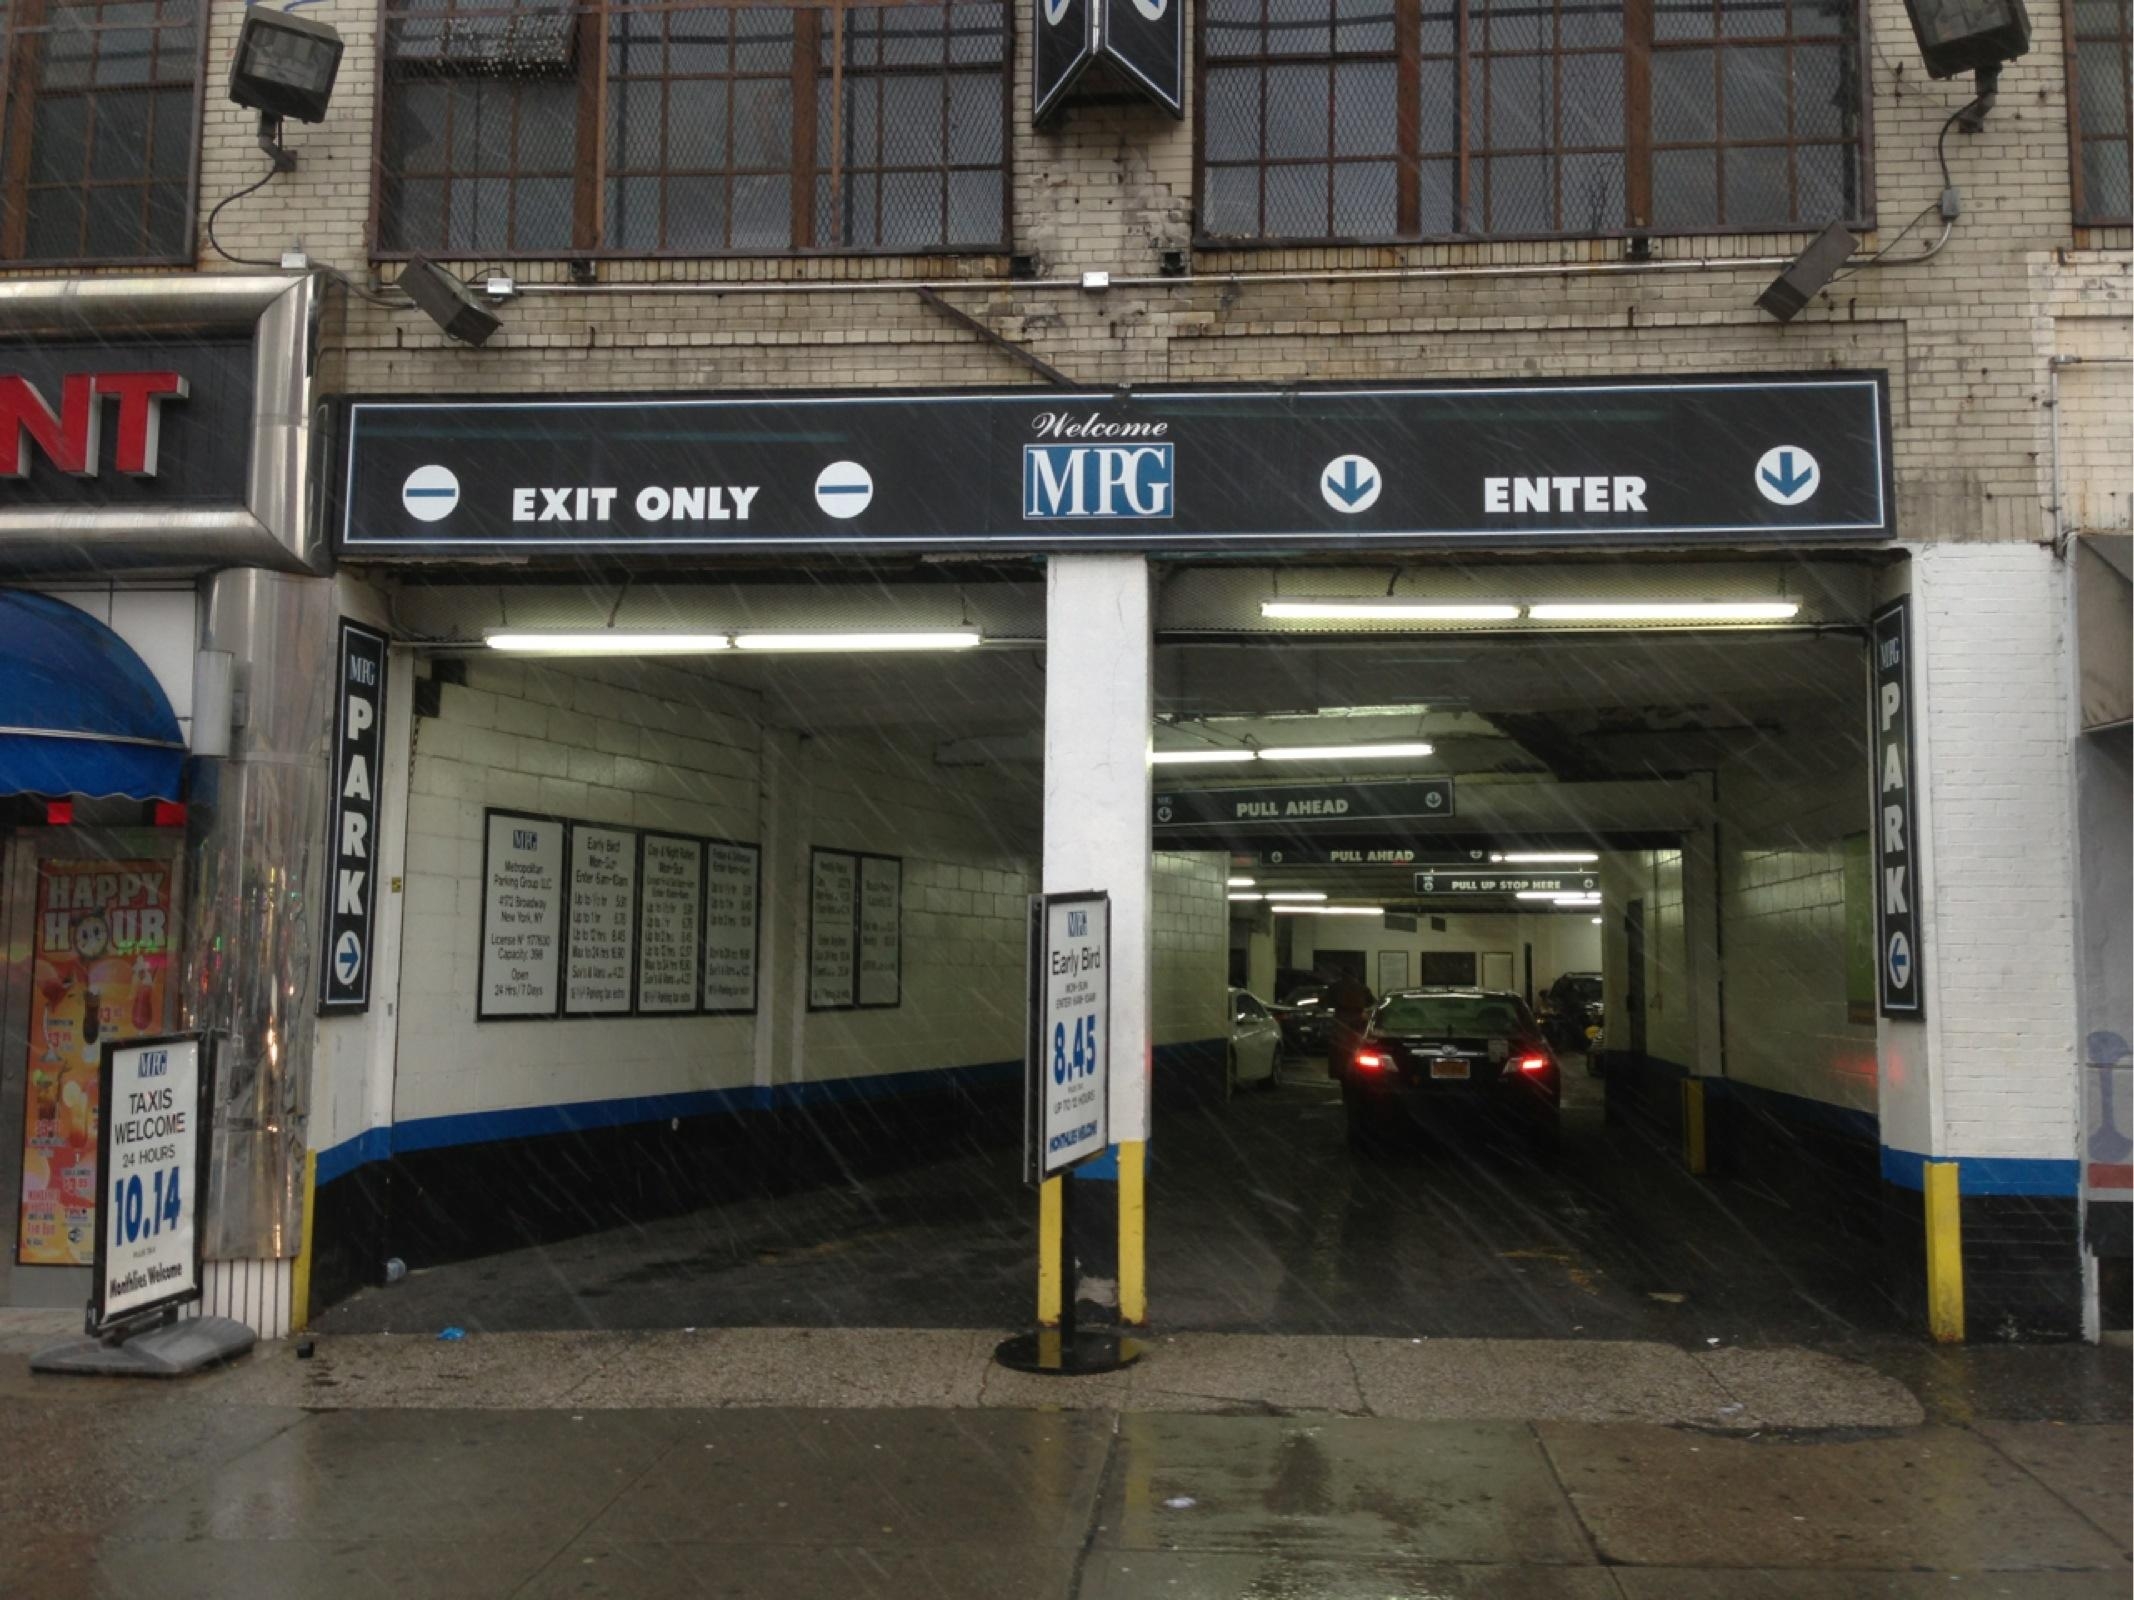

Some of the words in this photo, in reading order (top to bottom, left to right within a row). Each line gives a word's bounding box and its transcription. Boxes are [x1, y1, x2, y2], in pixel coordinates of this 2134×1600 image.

[0, 371, 190, 478] NT
[1031, 412, 1168, 438] Welcome
[1027, 447, 1169, 516] MPG
[1484, 476, 1648, 512] ENTER
[512, 487, 617, 521] EXIT
[635, 486, 760, 521] ONLY
[349, 654, 377, 687] MPG
[338, 695, 373, 915] PARK
[1236, 802, 1279, 817] PULL
[1286, 799, 1348, 816] AHEAD
[1881, 681, 1908, 914] PARK
[587, 837, 604, 853] Early
[607, 839, 620, 852] Bird
[1330, 851, 1363, 862] PULL
[1367, 850, 1415, 862] AHEAD
[47, 872, 163, 908] HAPPY
[494, 874, 518, 890] Parking
[520, 875, 539, 889] Group
[1452, 881, 1477, 890] PULL
[1481, 881, 1496, 889] UP
[1500, 880, 1529, 890] STOP
[1532, 880, 1561, 889] HERE
[511, 968, 529, 980] Open
[1052, 949, 1079, 977] Early
[1082, 945, 1100, 970] Bird
[1055, 1015, 1096, 1085] 8.45
[129, 1088, 173, 1115] TAXIS
[115, 1112, 186, 1146] WELCOME
[122, 1153, 136, 1168] 24
[140, 1144, 176, 1165] HOURS
[115, 1166, 181, 1247] 10.14
[110, 1269, 148, 1298] Monthlies
[147, 1262, 182, 1285] Welcome
